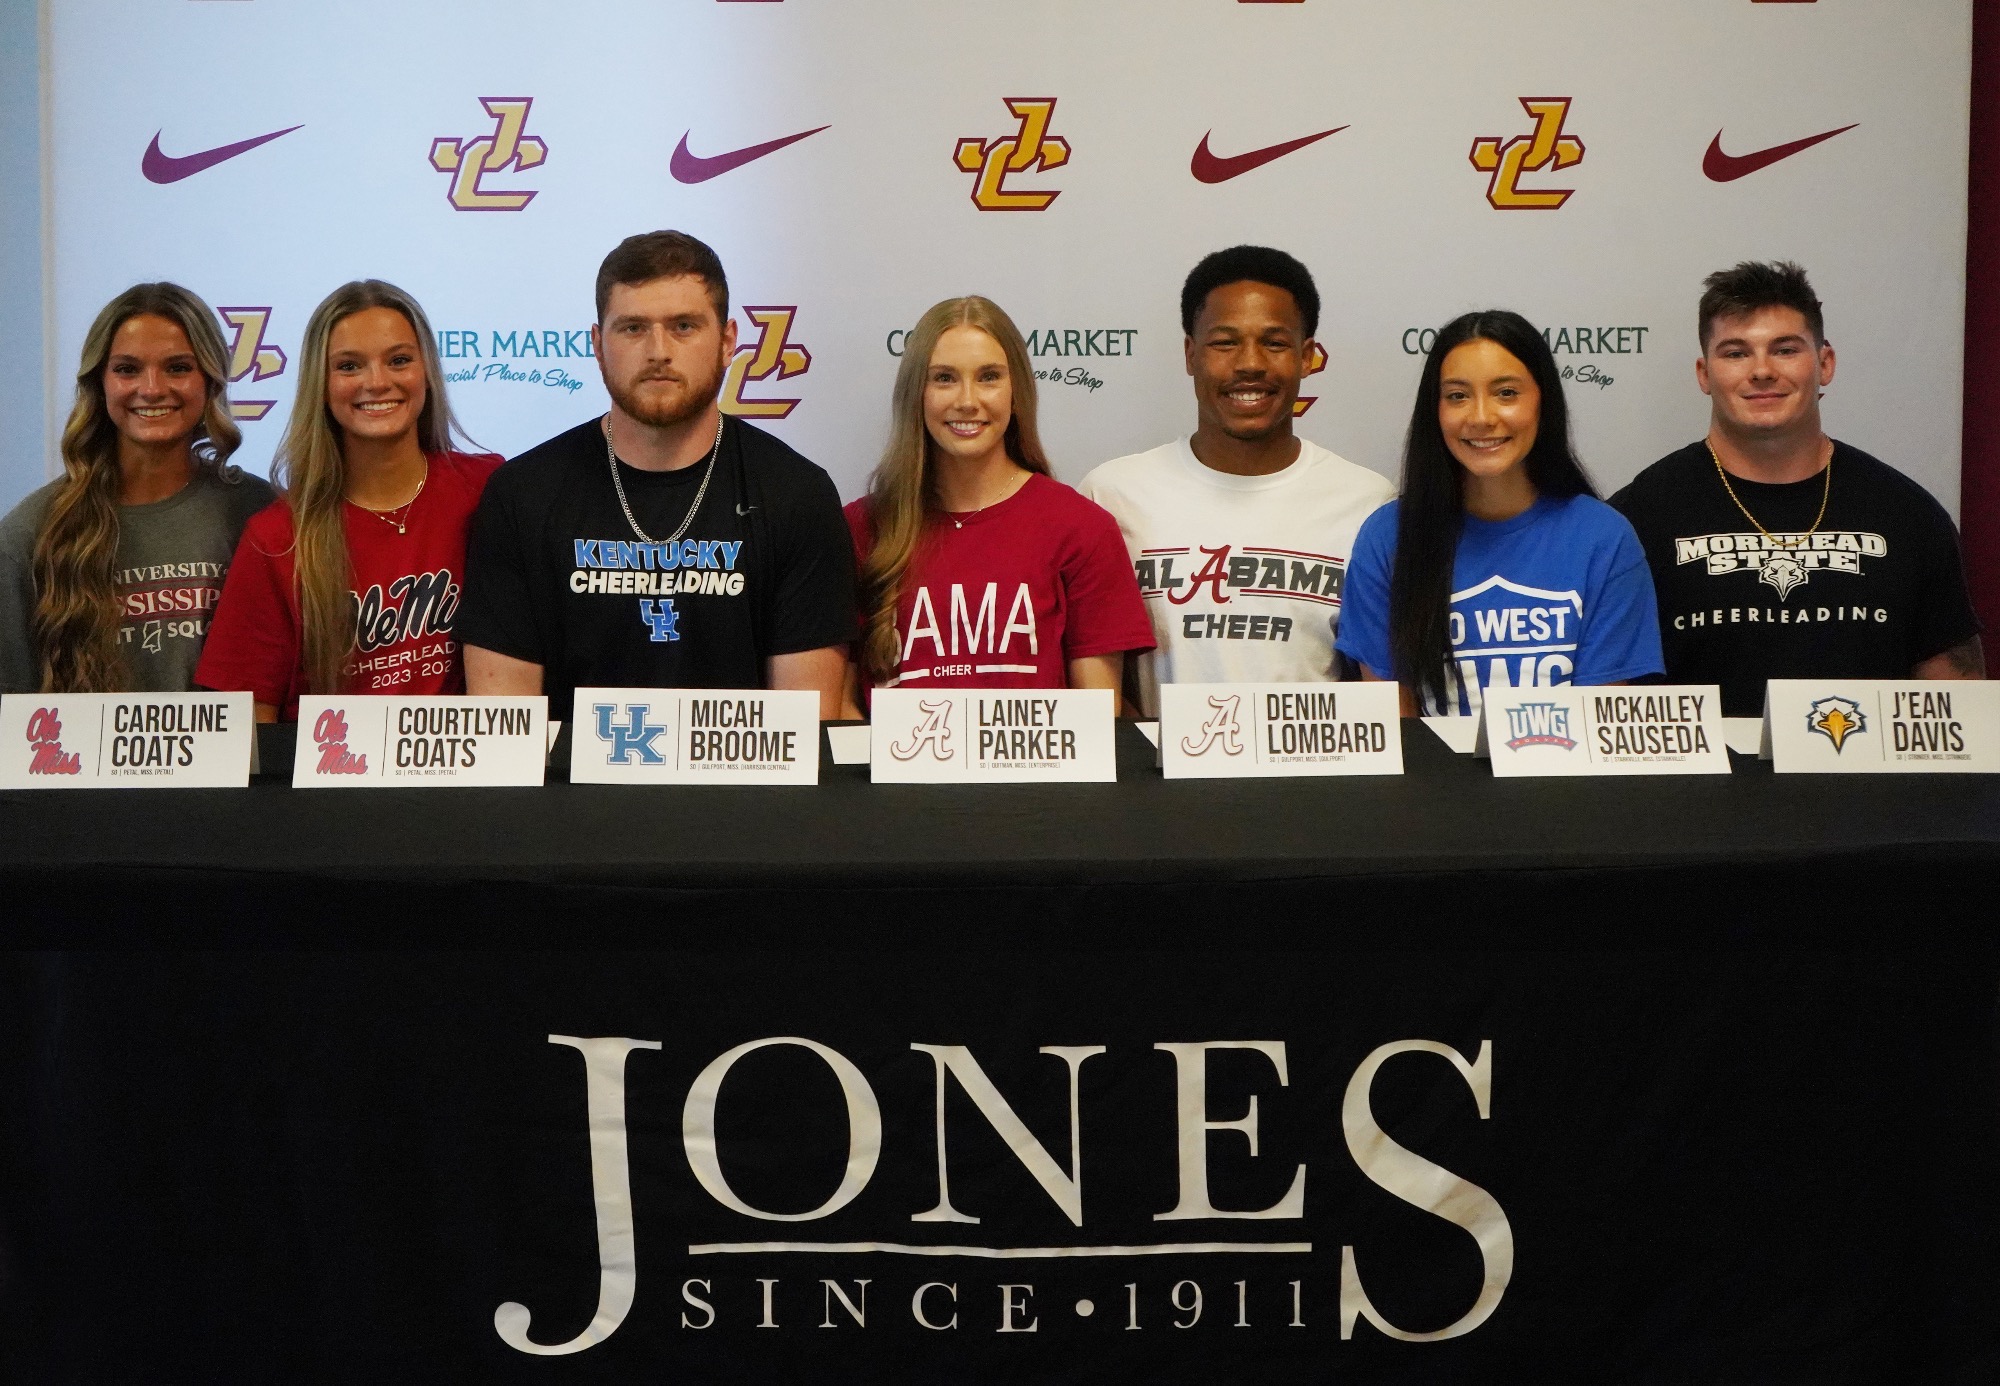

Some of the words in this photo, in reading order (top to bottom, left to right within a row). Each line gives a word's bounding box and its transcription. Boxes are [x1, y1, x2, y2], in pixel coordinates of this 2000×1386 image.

[491, 330, 595, 358] MARKE
[1546, 327, 1649, 354] ARKET
[446, 363, 480, 383] ecial
[482, 363, 527, 383] Place
[528, 368, 542, 383] to
[543, 368, 584, 395] Shop
[1049, 367, 1063, 382] to
[1064, 367, 1104, 393] Shop
[1560, 365, 1574, 380] to
[1575, 364, 1615, 390] Shop
[574, 539, 743, 570] KENTUCKY
[1676, 532, 1887, 565] MOREHEAD
[113, 561, 223, 585] NIVERSITY
[569, 571, 745, 596] CHEERLEADING
[1135, 544, 1345, 605] ALABAMA
[389, 568, 460, 642] Mi
[639, 598, 680, 641] UK
[1673, 606, 1889, 630] CHEERLEADING
[892, 581, 1038, 667] AMA
[1182, 613, 1293, 642] CHEER
[1449, 611, 1466, 646] O
[1475, 606, 1571, 643] WEST
[343, 641, 457, 676] CHEERLEAD
[933, 664, 972, 678] CHEER
[114, 703, 229, 733] CAROLINE
[691, 699, 764, 728] MICAH
[979, 699, 1058, 727] LAINEY
[1267, 693, 1336, 721] DENIM
[1595, 695, 1705, 724] MCKAILEY
[1893, 691, 1953, 719] J'EAN
[26, 707, 61, 742] Ole
[313, 709, 349, 744] Ole
[398, 707, 531, 736] COURTLYNN
[592, 703, 667, 765] UK
[890, 699, 954, 761] A
[1181, 694, 1244, 757] A
[1507, 704, 1569, 739] UWG
[1893, 721, 1964, 752] DAVIS
[112, 735, 194, 767] COATS
[396, 737, 477, 768] COATS
[690, 730, 797, 762] BROOME
[979, 729, 1076, 760] PARKER
[1268, 722, 1386, 754] LOMBARD
[1597, 724, 1711, 755] SAUSEDA
[28, 741, 82, 775] Miss
[316, 742, 369, 775] Miss
[494, 1034, 1514, 1355] JONES
[681, 1278, 1038, 1333] SINCE
[1124, 1279, 1306, 1331] 1911
